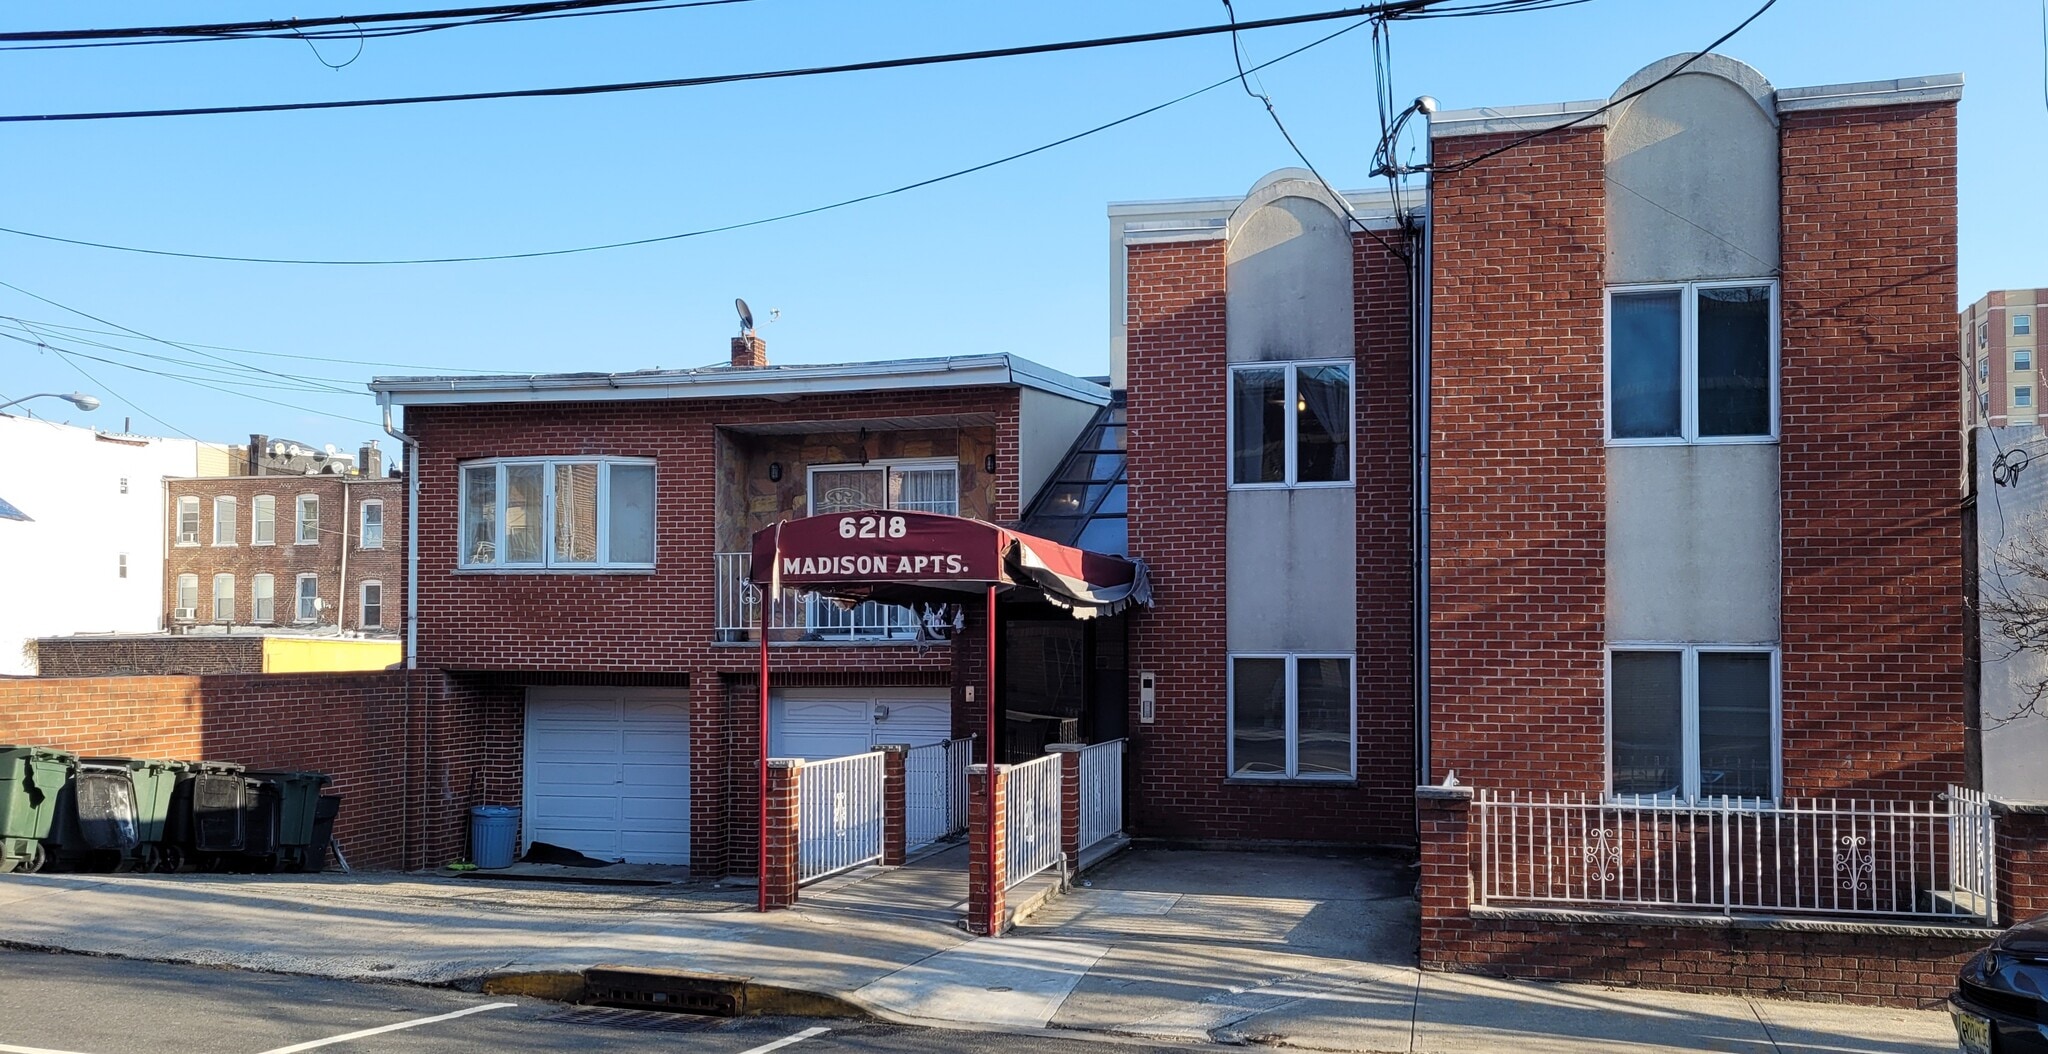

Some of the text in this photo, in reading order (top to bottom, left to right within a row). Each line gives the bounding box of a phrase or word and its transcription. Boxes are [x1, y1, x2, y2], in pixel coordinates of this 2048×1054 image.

[838, 516, 907, 539] 6218
[783, 554, 969, 575] MADISON APTS.
